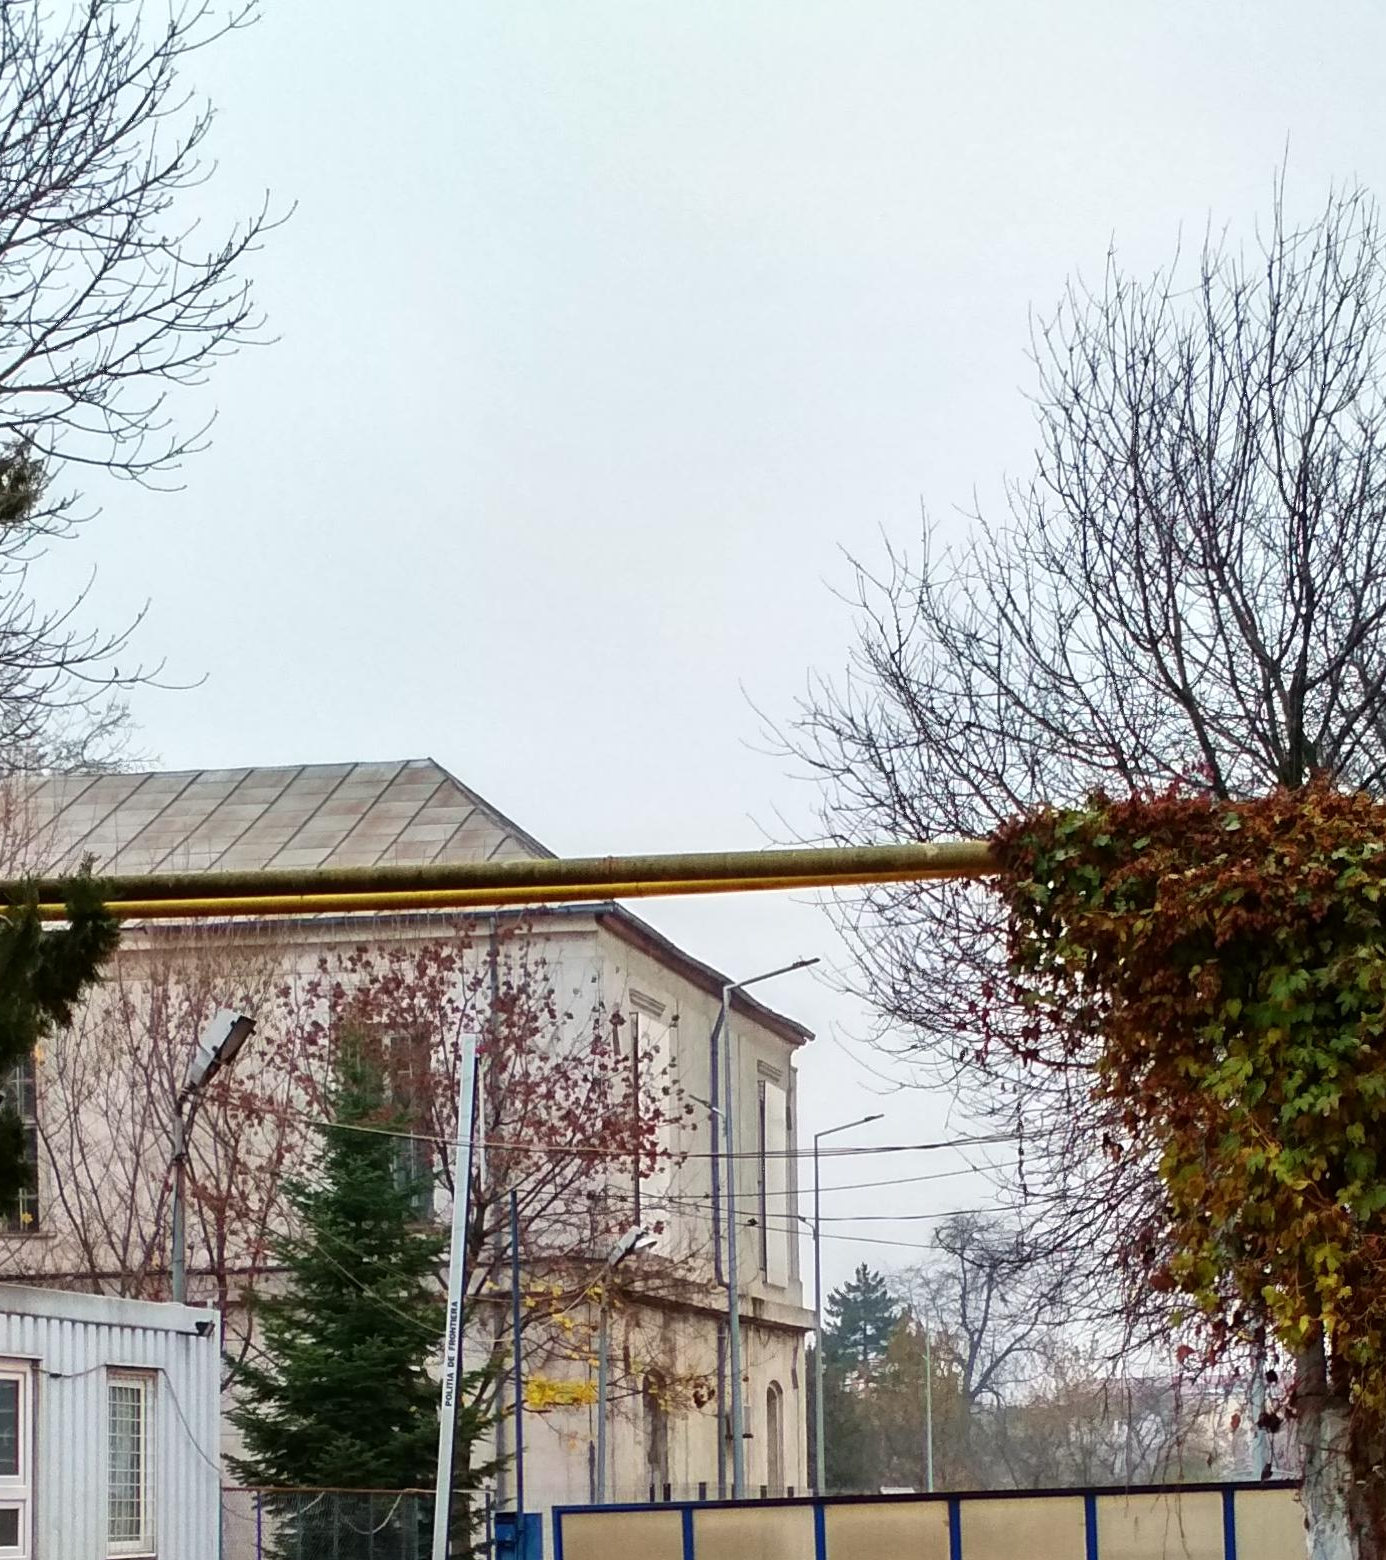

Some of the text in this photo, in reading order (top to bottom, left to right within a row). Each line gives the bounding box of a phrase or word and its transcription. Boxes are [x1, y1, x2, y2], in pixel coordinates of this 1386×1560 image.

[445, 1301, 458, 1407] POLITIA DE FRONTIERA
